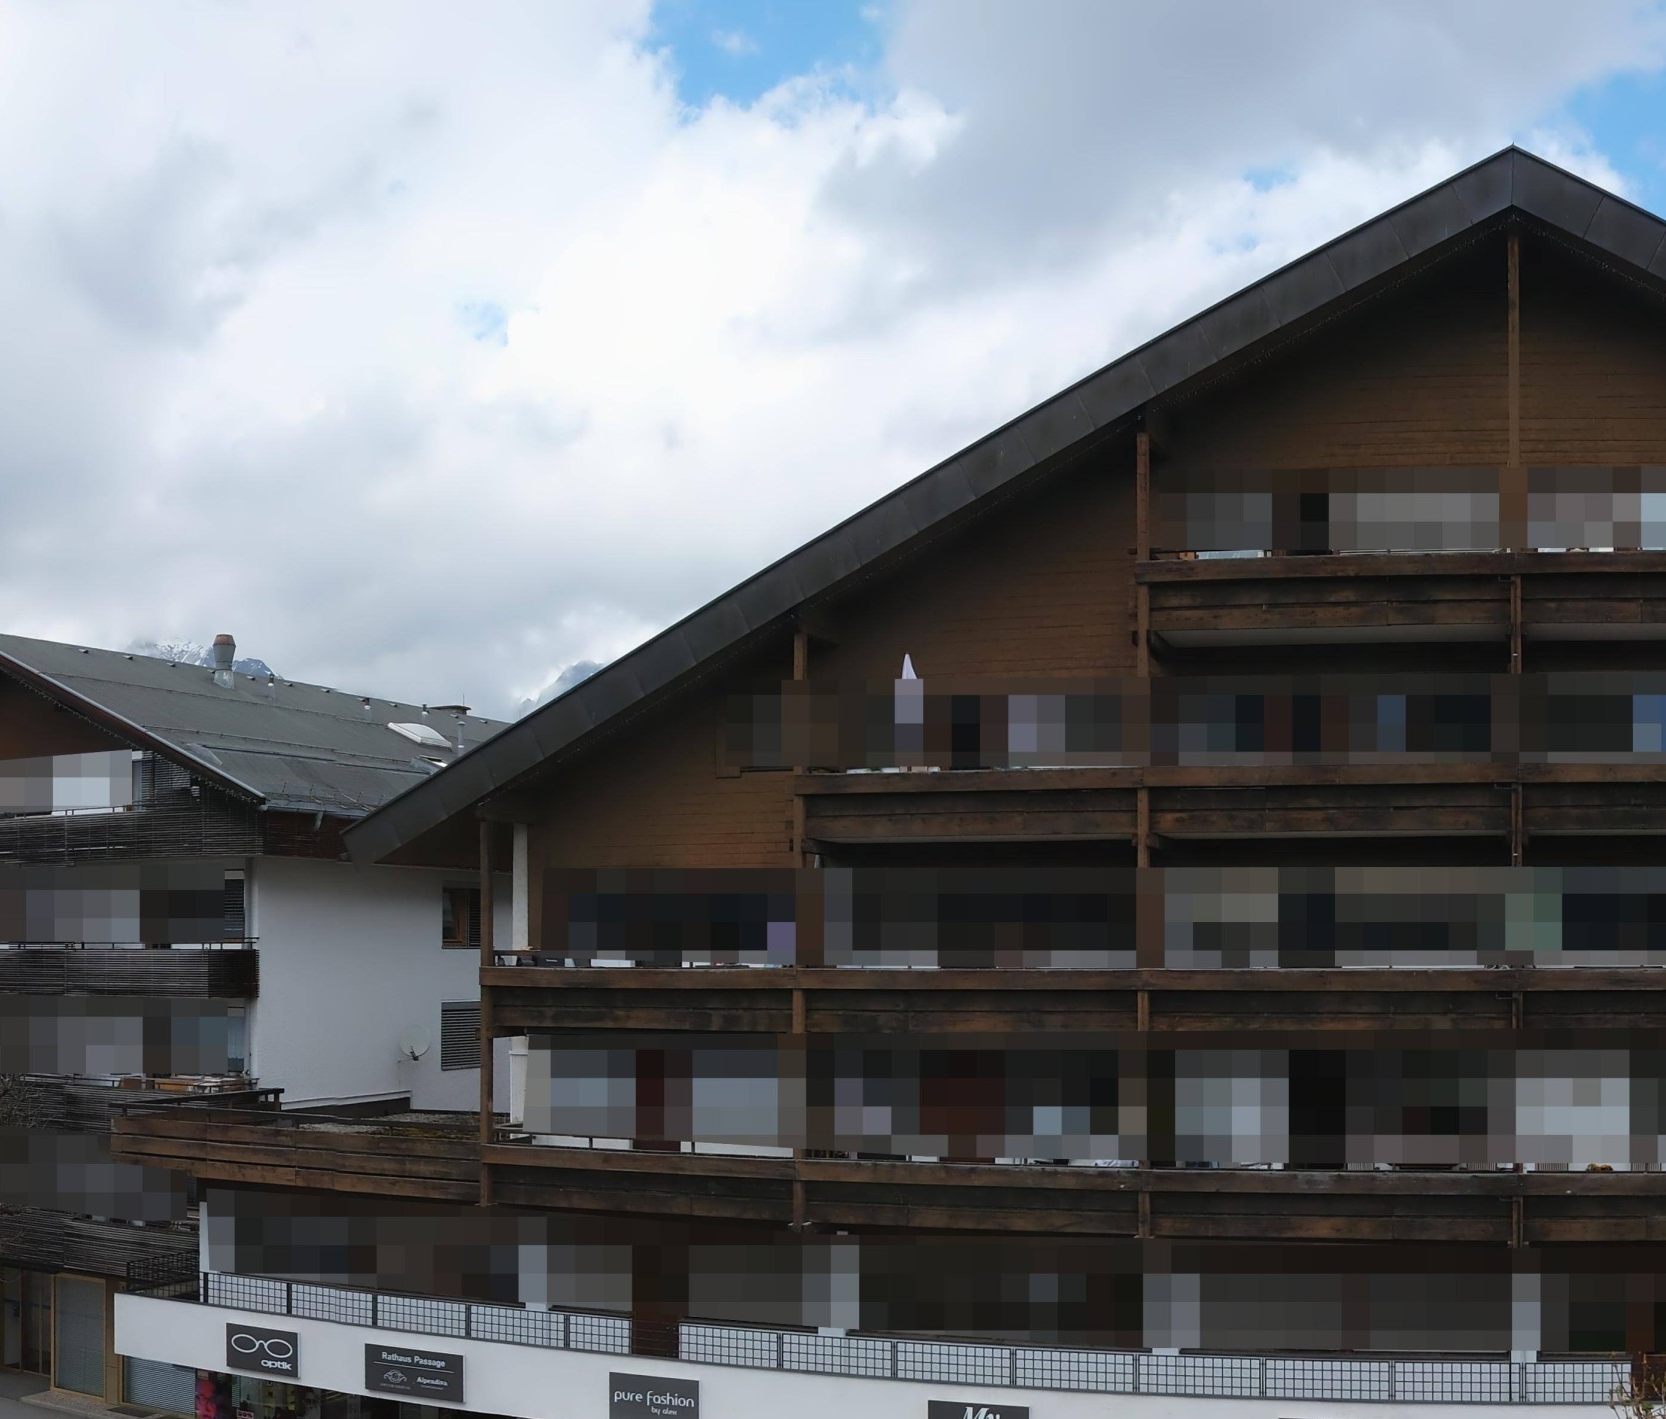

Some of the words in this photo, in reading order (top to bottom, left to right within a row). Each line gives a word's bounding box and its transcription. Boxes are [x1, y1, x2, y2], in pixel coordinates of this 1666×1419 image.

[261, 1359, 293, 1371] optik
[381, 1352, 412, 1364] Rathaus
[414, 1356, 446, 1368] Passage
[614, 1391, 643, 1403] pure
[646, 1390, 695, 1408] fashion
